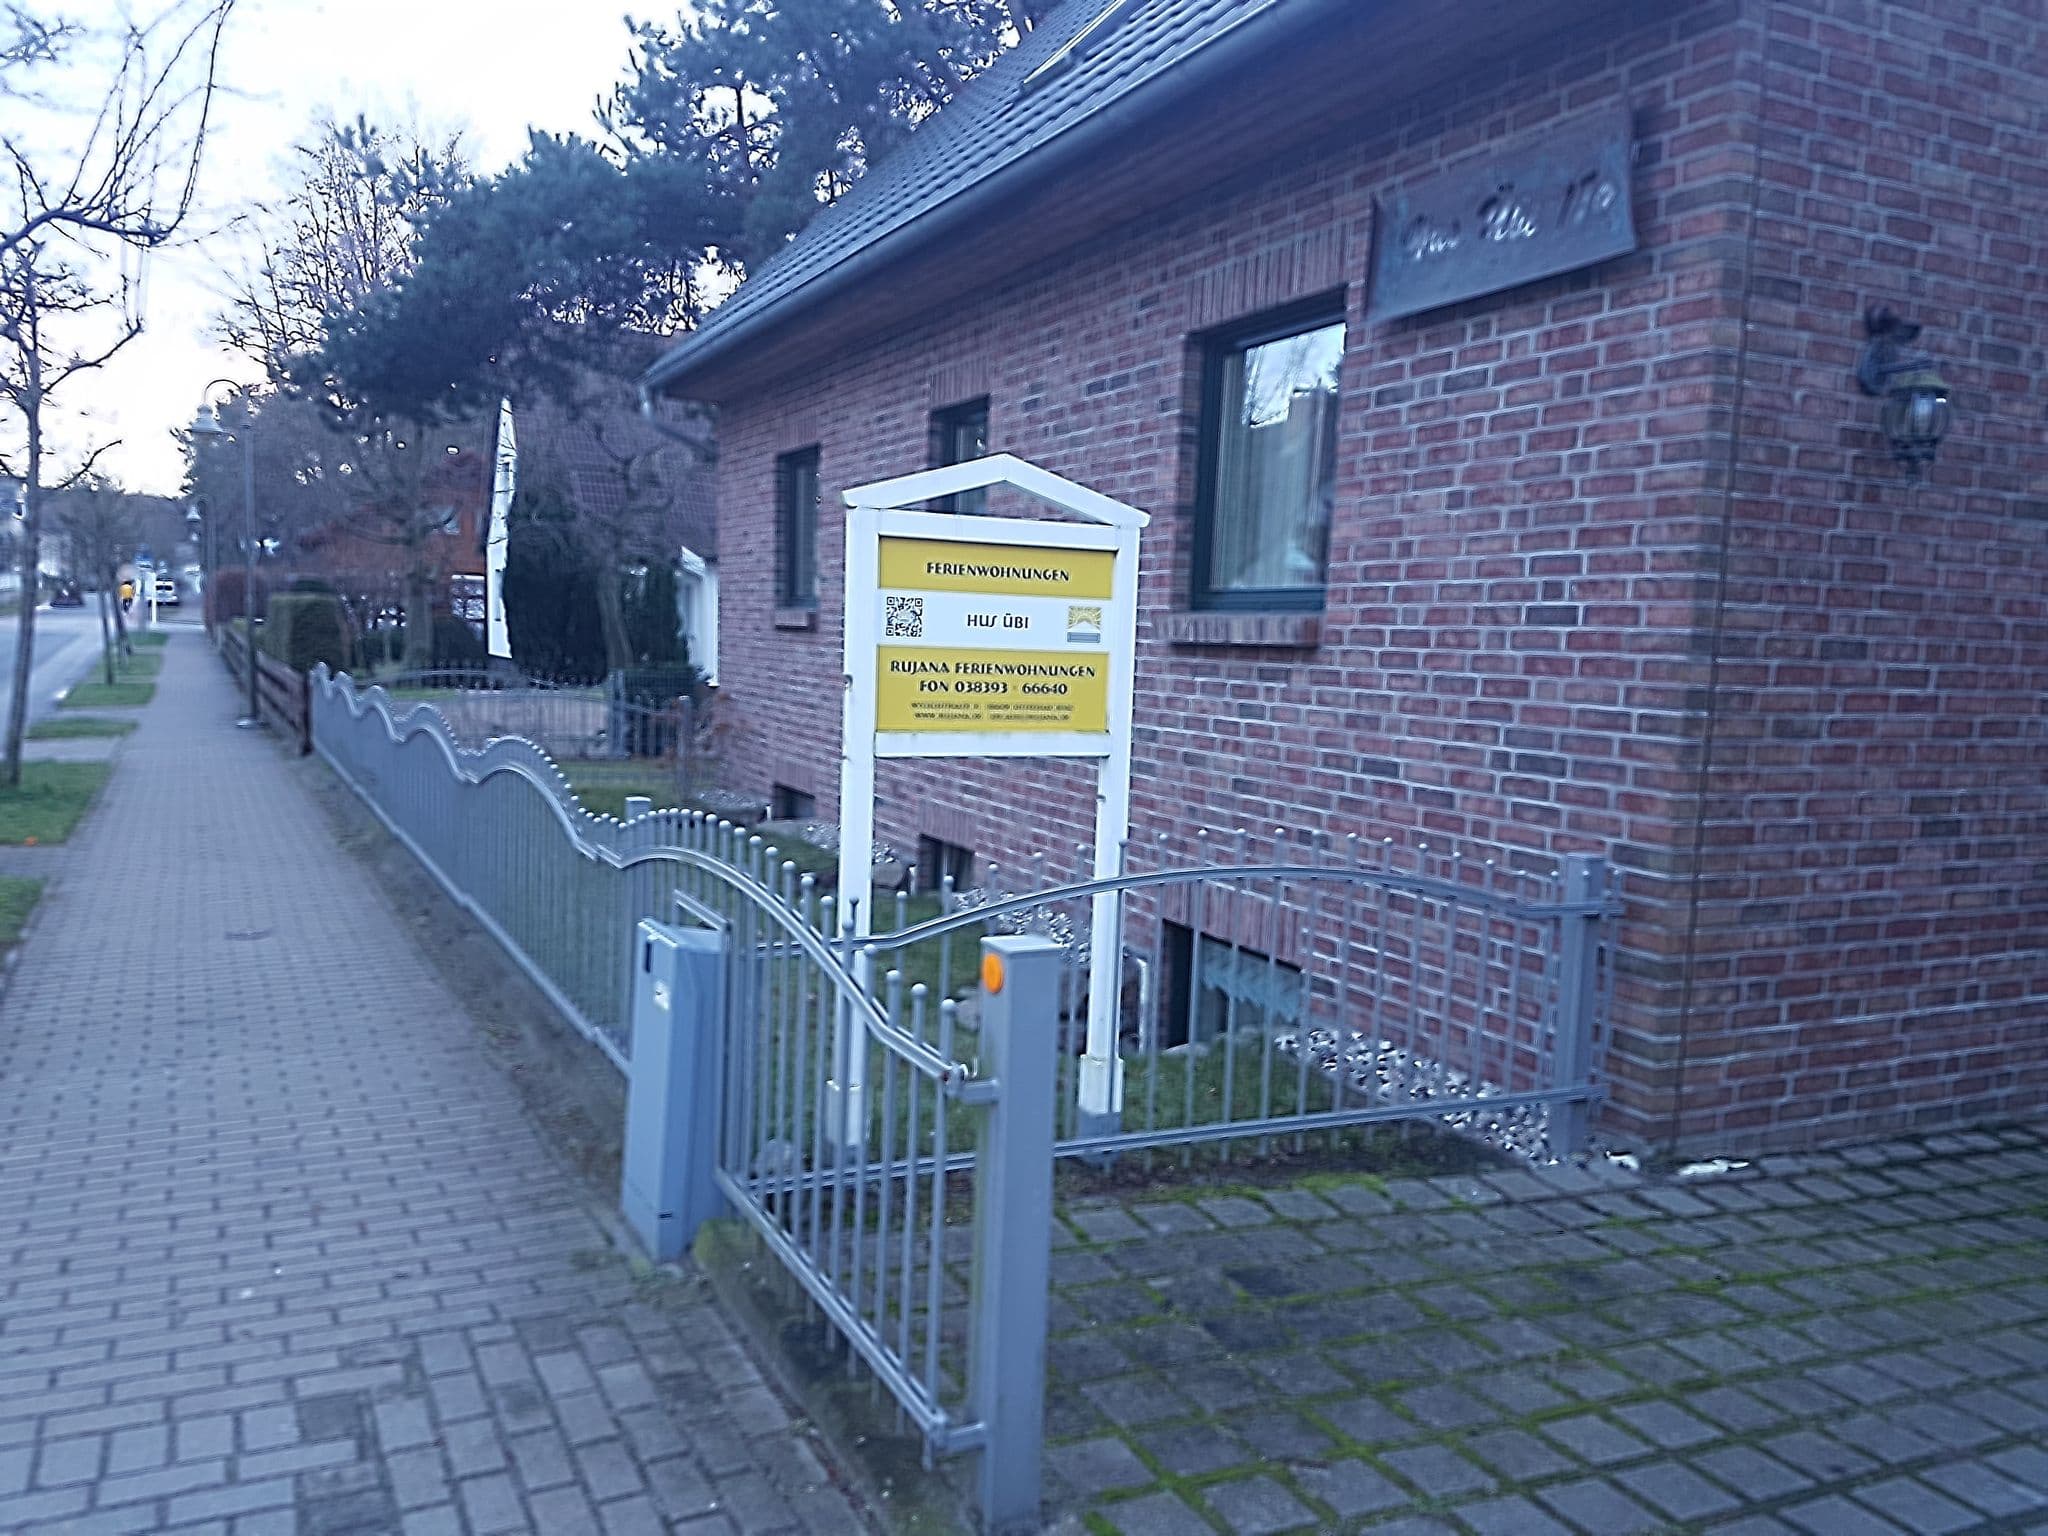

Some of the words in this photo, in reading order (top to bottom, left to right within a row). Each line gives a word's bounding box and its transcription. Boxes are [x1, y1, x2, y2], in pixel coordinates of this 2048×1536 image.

[927, 562, 1069, 581] FERIENWOHNUNGEN
[1003, 613, 1029, 629] ÜBI
[890, 660, 950, 674] RUJANA
[955, 663, 1095, 677] FERIENWOHNUNGEN
[919, 680, 949, 692] FON
[955, 681, 1008, 693] 038393
